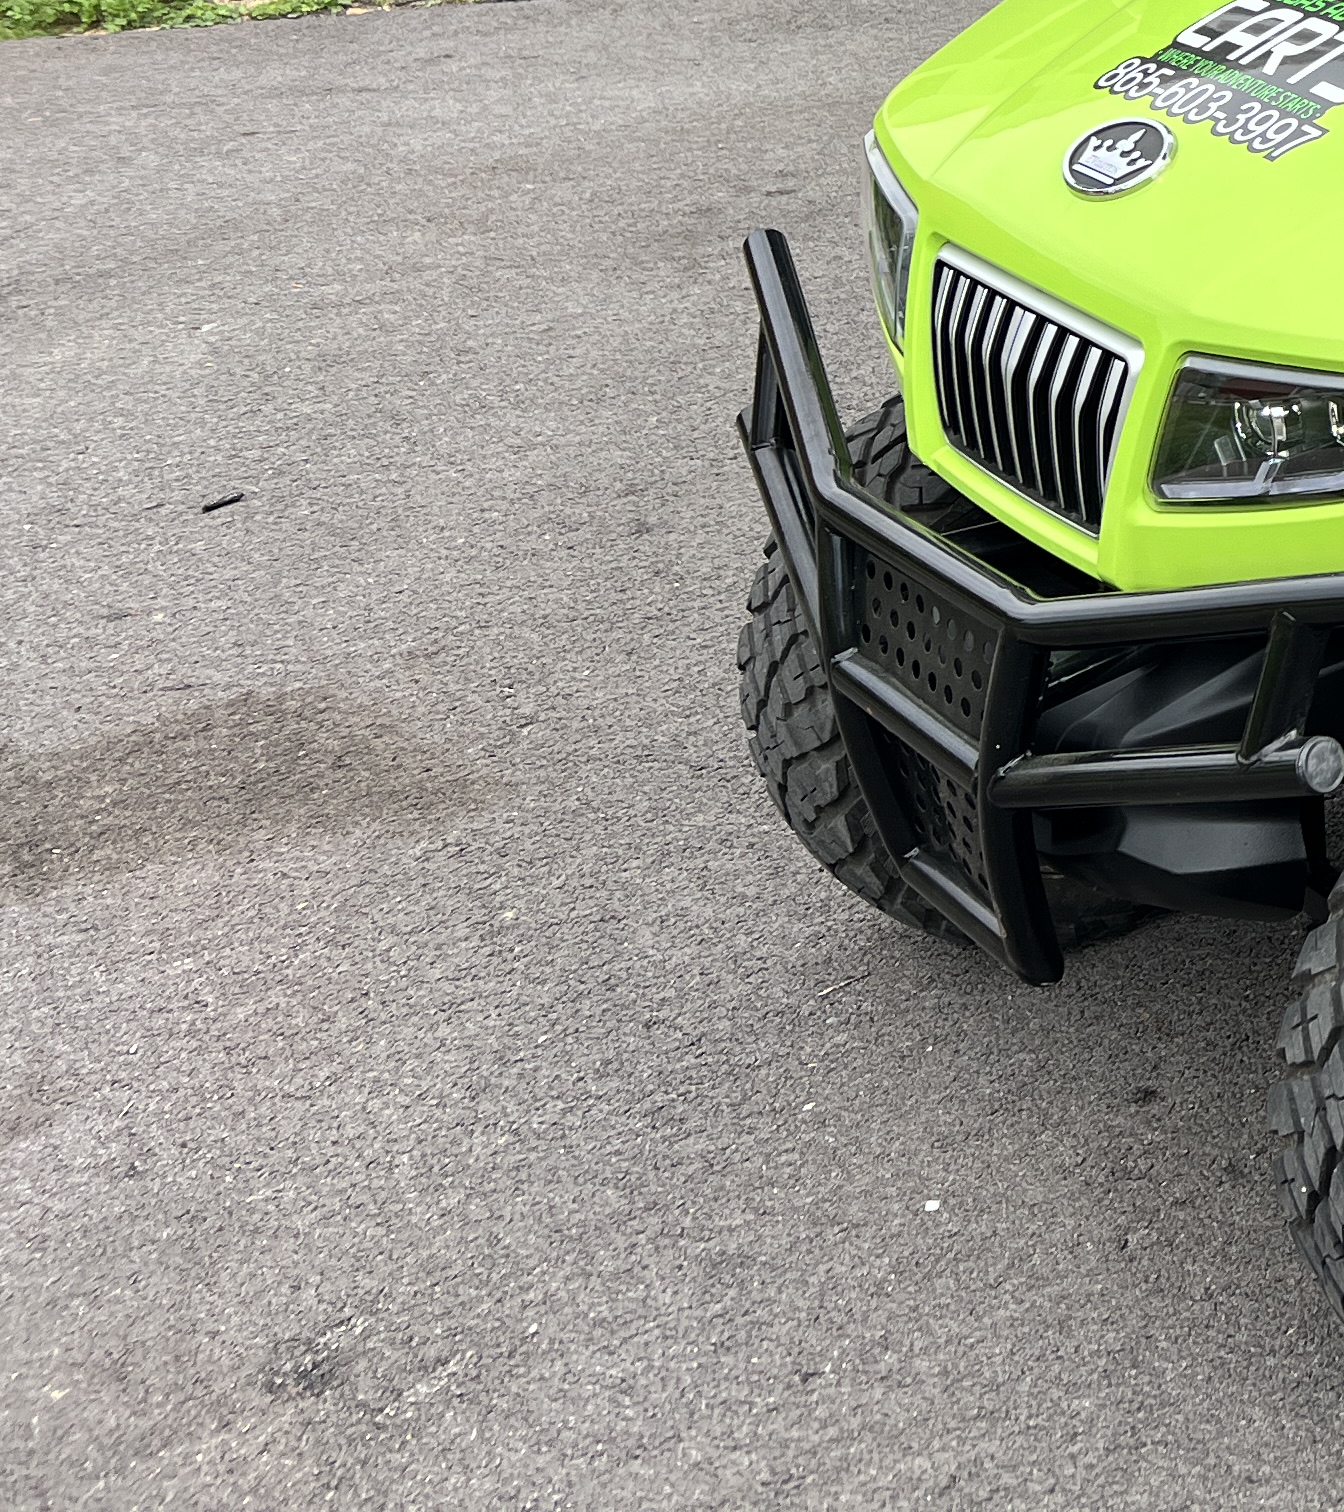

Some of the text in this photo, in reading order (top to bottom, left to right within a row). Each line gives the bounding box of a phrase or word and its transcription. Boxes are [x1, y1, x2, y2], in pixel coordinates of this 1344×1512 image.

[1097, 57, 1323, 158] 865-603-3997
[1157, 48, 1321, 119] WHERE YOUR ADVENTURE STARTS
